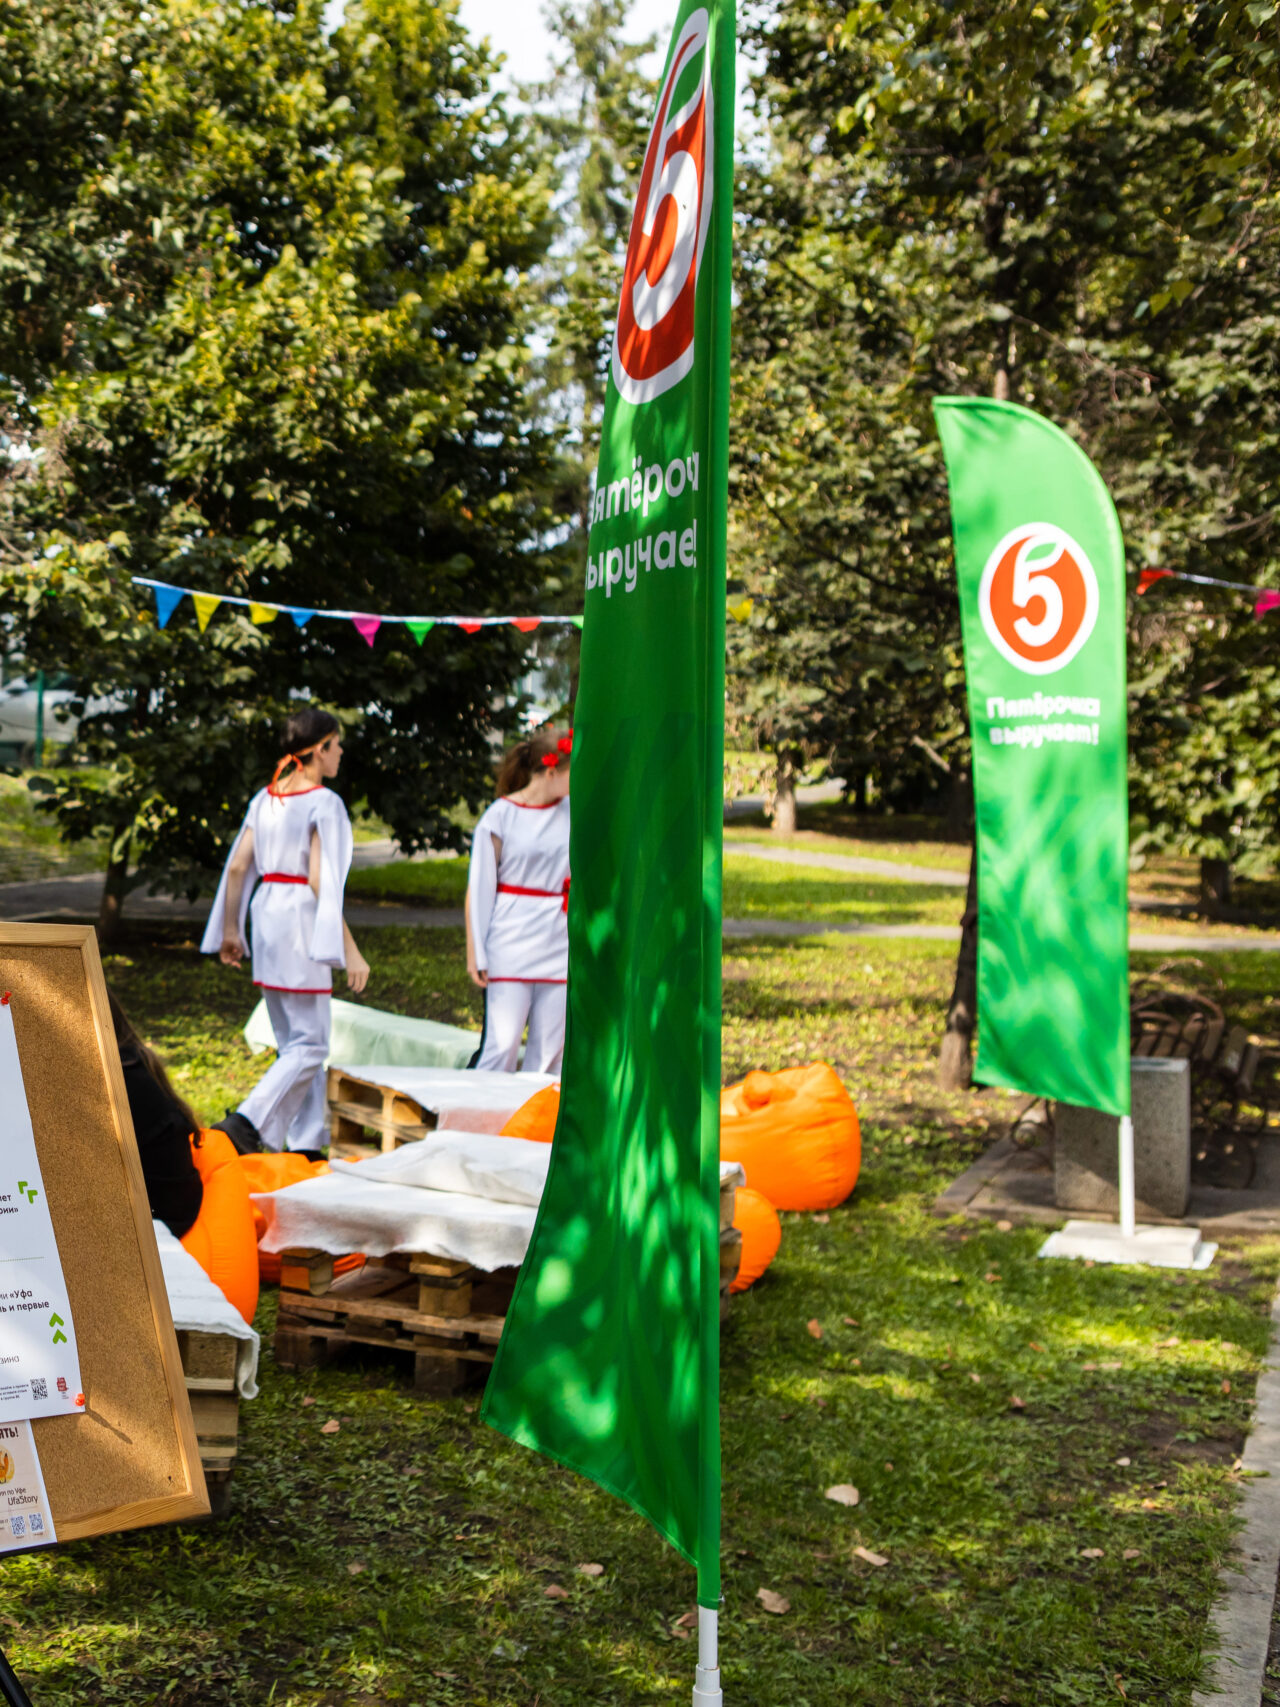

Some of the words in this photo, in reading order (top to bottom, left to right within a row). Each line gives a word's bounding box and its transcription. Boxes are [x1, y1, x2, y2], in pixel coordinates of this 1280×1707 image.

[9, 1288, 32, 1300] «Уфа
[16, 1300, 49, 1312] первые
[7, 1494, 39, 1506] UfaStory
